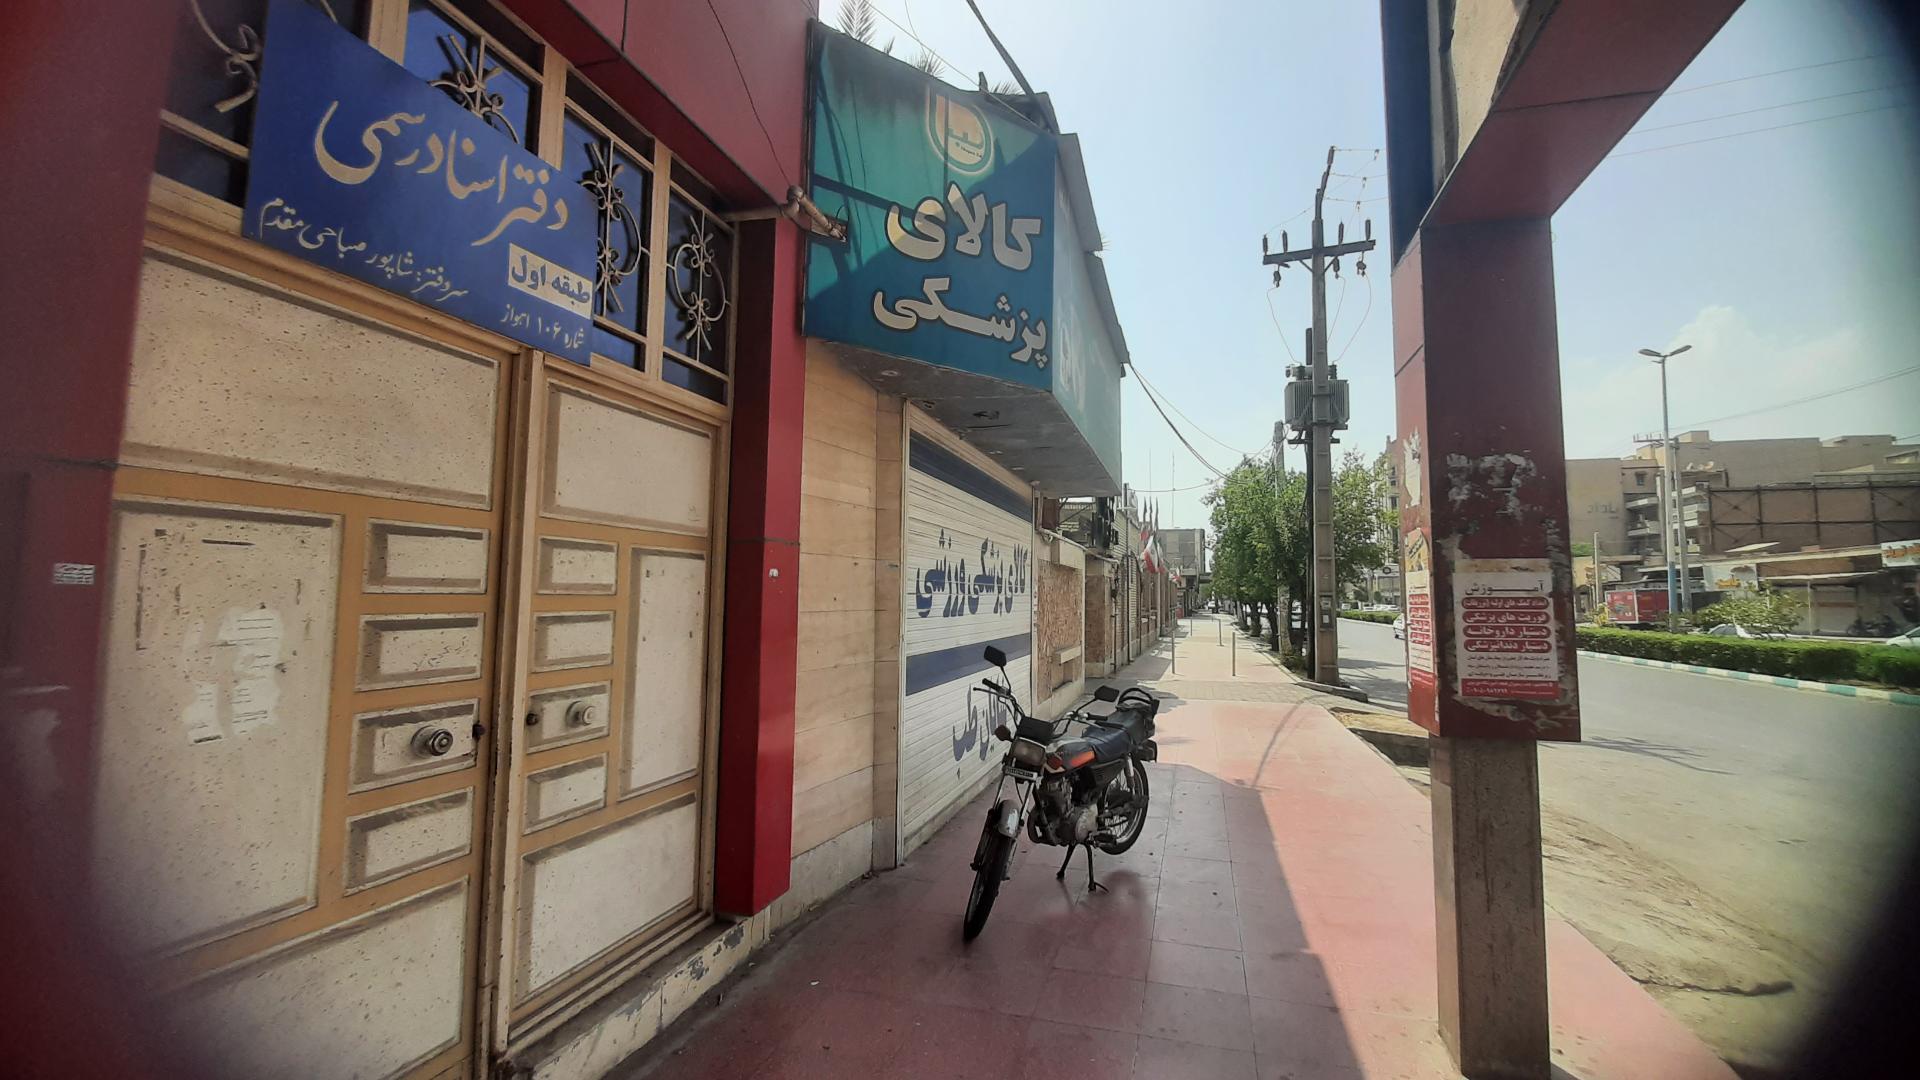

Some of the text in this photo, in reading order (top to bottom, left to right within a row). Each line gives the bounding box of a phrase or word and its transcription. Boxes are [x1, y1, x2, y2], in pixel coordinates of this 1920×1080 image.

[259, 197, 304, 240] مقدم
[314, 100, 569, 247] دفتر اسناد رسمی
[365, 251, 413, 279] شاپور
[884, 180, 1043, 272] کالای
[511, 254, 591, 306] طبقه اول
[873, 276, 1049, 370] پزشکی
[915, 528, 1029, 618] کالای پزشکی ورزشی
[1464, 580, 1545, 596] آموزش
[952, 682, 978, 780] طب
